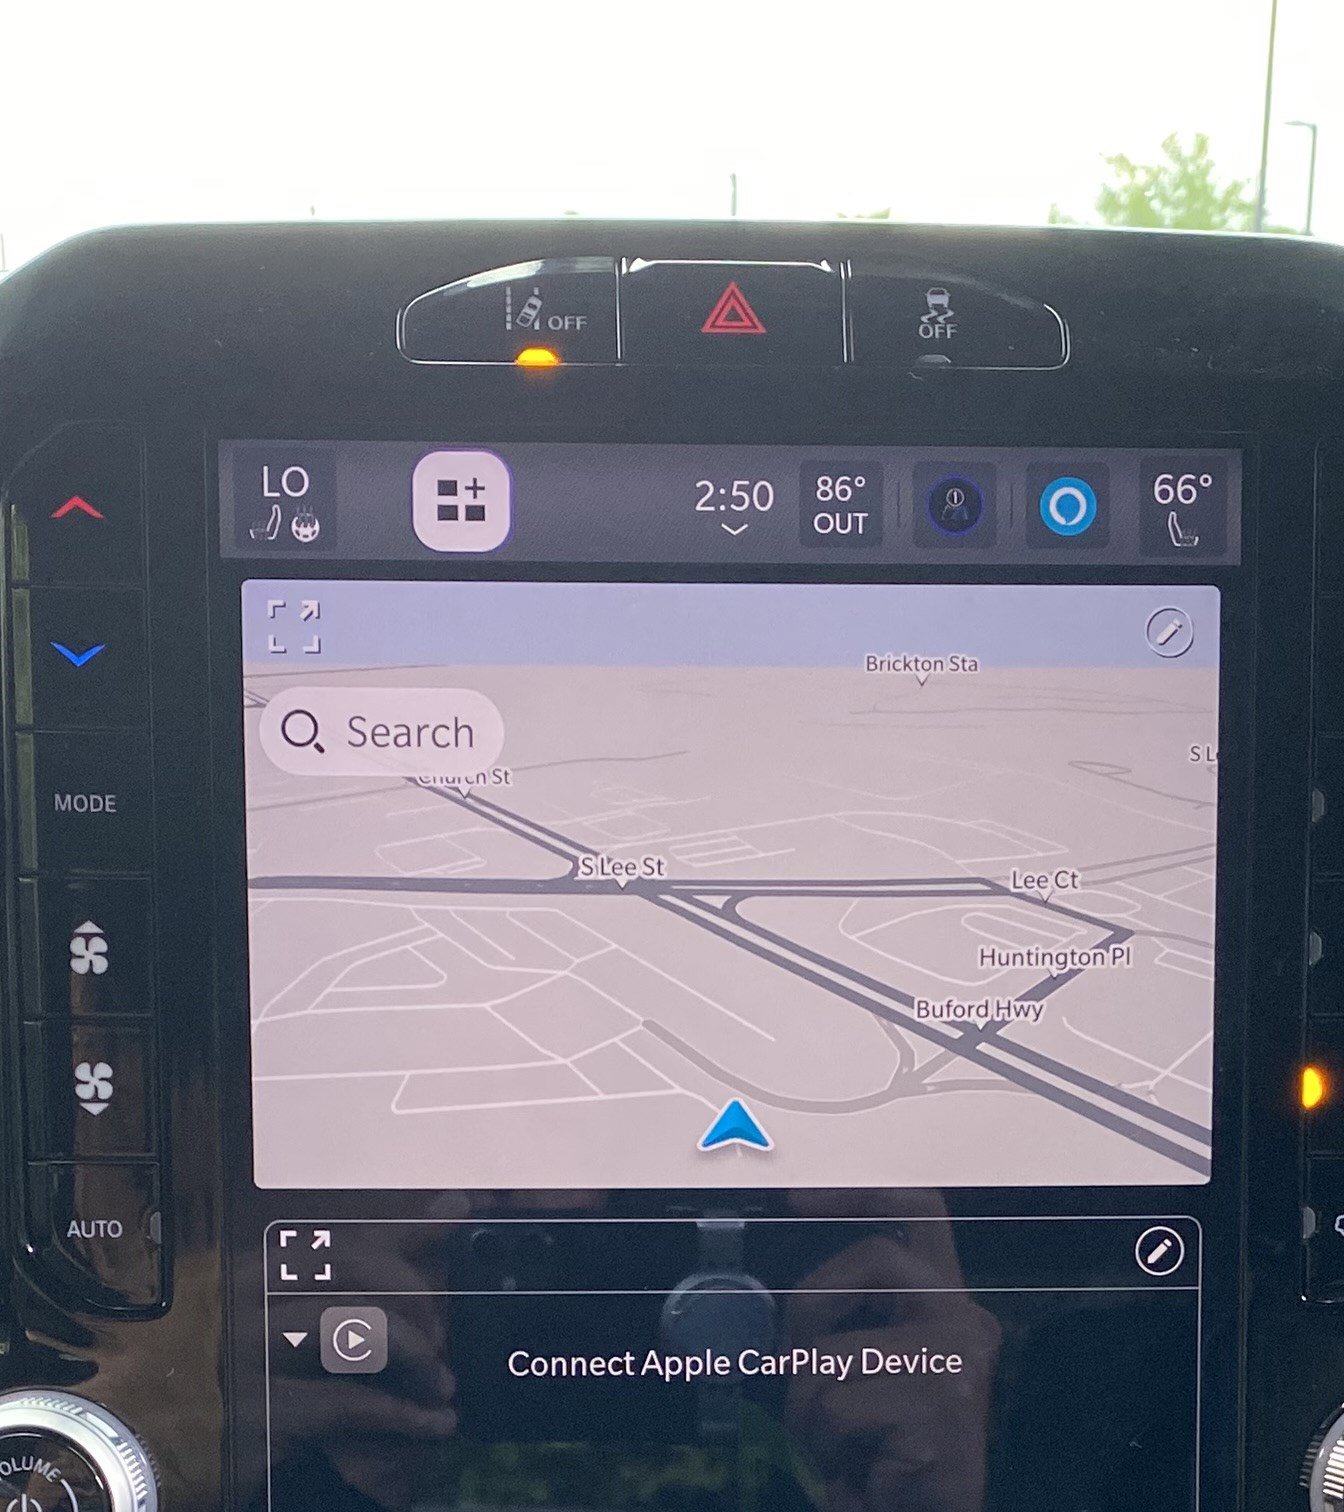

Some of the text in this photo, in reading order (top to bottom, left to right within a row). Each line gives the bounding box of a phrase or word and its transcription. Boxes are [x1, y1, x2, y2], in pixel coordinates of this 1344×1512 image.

[547, 315, 586, 331] OFF
[918, 323, 957, 340] OFF
[263, 465, 310, 497] LO
[816, 475, 866, 502] 86°
[1154, 473, 1213, 505] 66°
[695, 480, 774, 512] 2:50
[813, 512, 869, 534] OUT
[866, 655, 978, 672] Brickton Sta
[347, 715, 474, 749] Search
[1190, 745, 1201, 762] S
[492, 768, 510, 785] St
[54, 793, 117, 813] MODE
[580, 857, 666, 877] S Lee St
[1012, 871, 1079, 890] Lee Ct
[980, 947, 1131, 972] Huntington Pl
[916, 1000, 1045, 1023] Buford Hwy
[67, 1219, 123, 1239] AUTO
[508, 1347, 963, 1382] Connect Apple CarPlay Device
